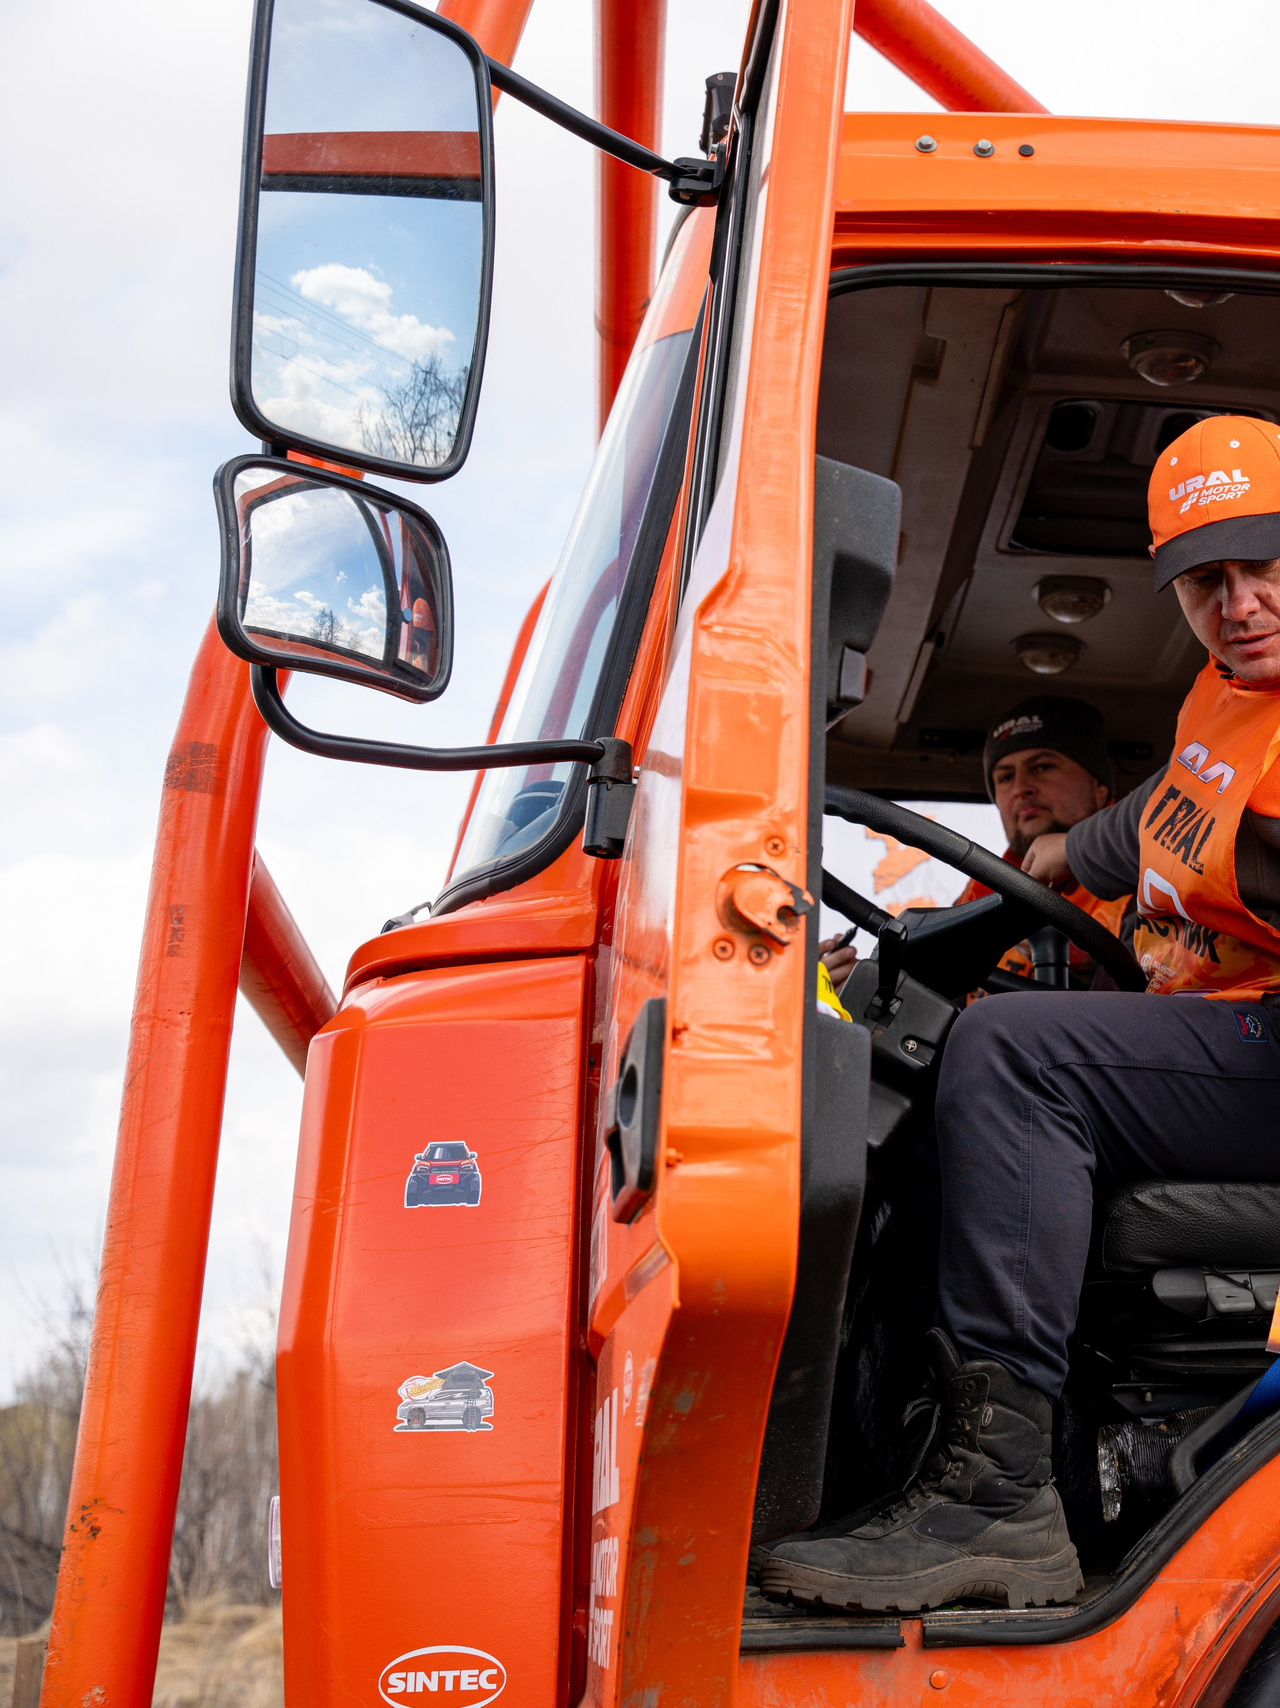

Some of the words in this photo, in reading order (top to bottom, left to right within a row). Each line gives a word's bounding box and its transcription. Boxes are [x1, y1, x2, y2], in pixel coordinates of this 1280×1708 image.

[1169, 469, 1250, 501] URAL
[1198, 491, 1246, 506] SPORT
[1200, 483, 1251, 497] MOTOR
[1145, 783, 1216, 876] TRIAL
[592, 1387, 620, 1516] RAL
[387, 1668, 498, 1694] SINTEC
